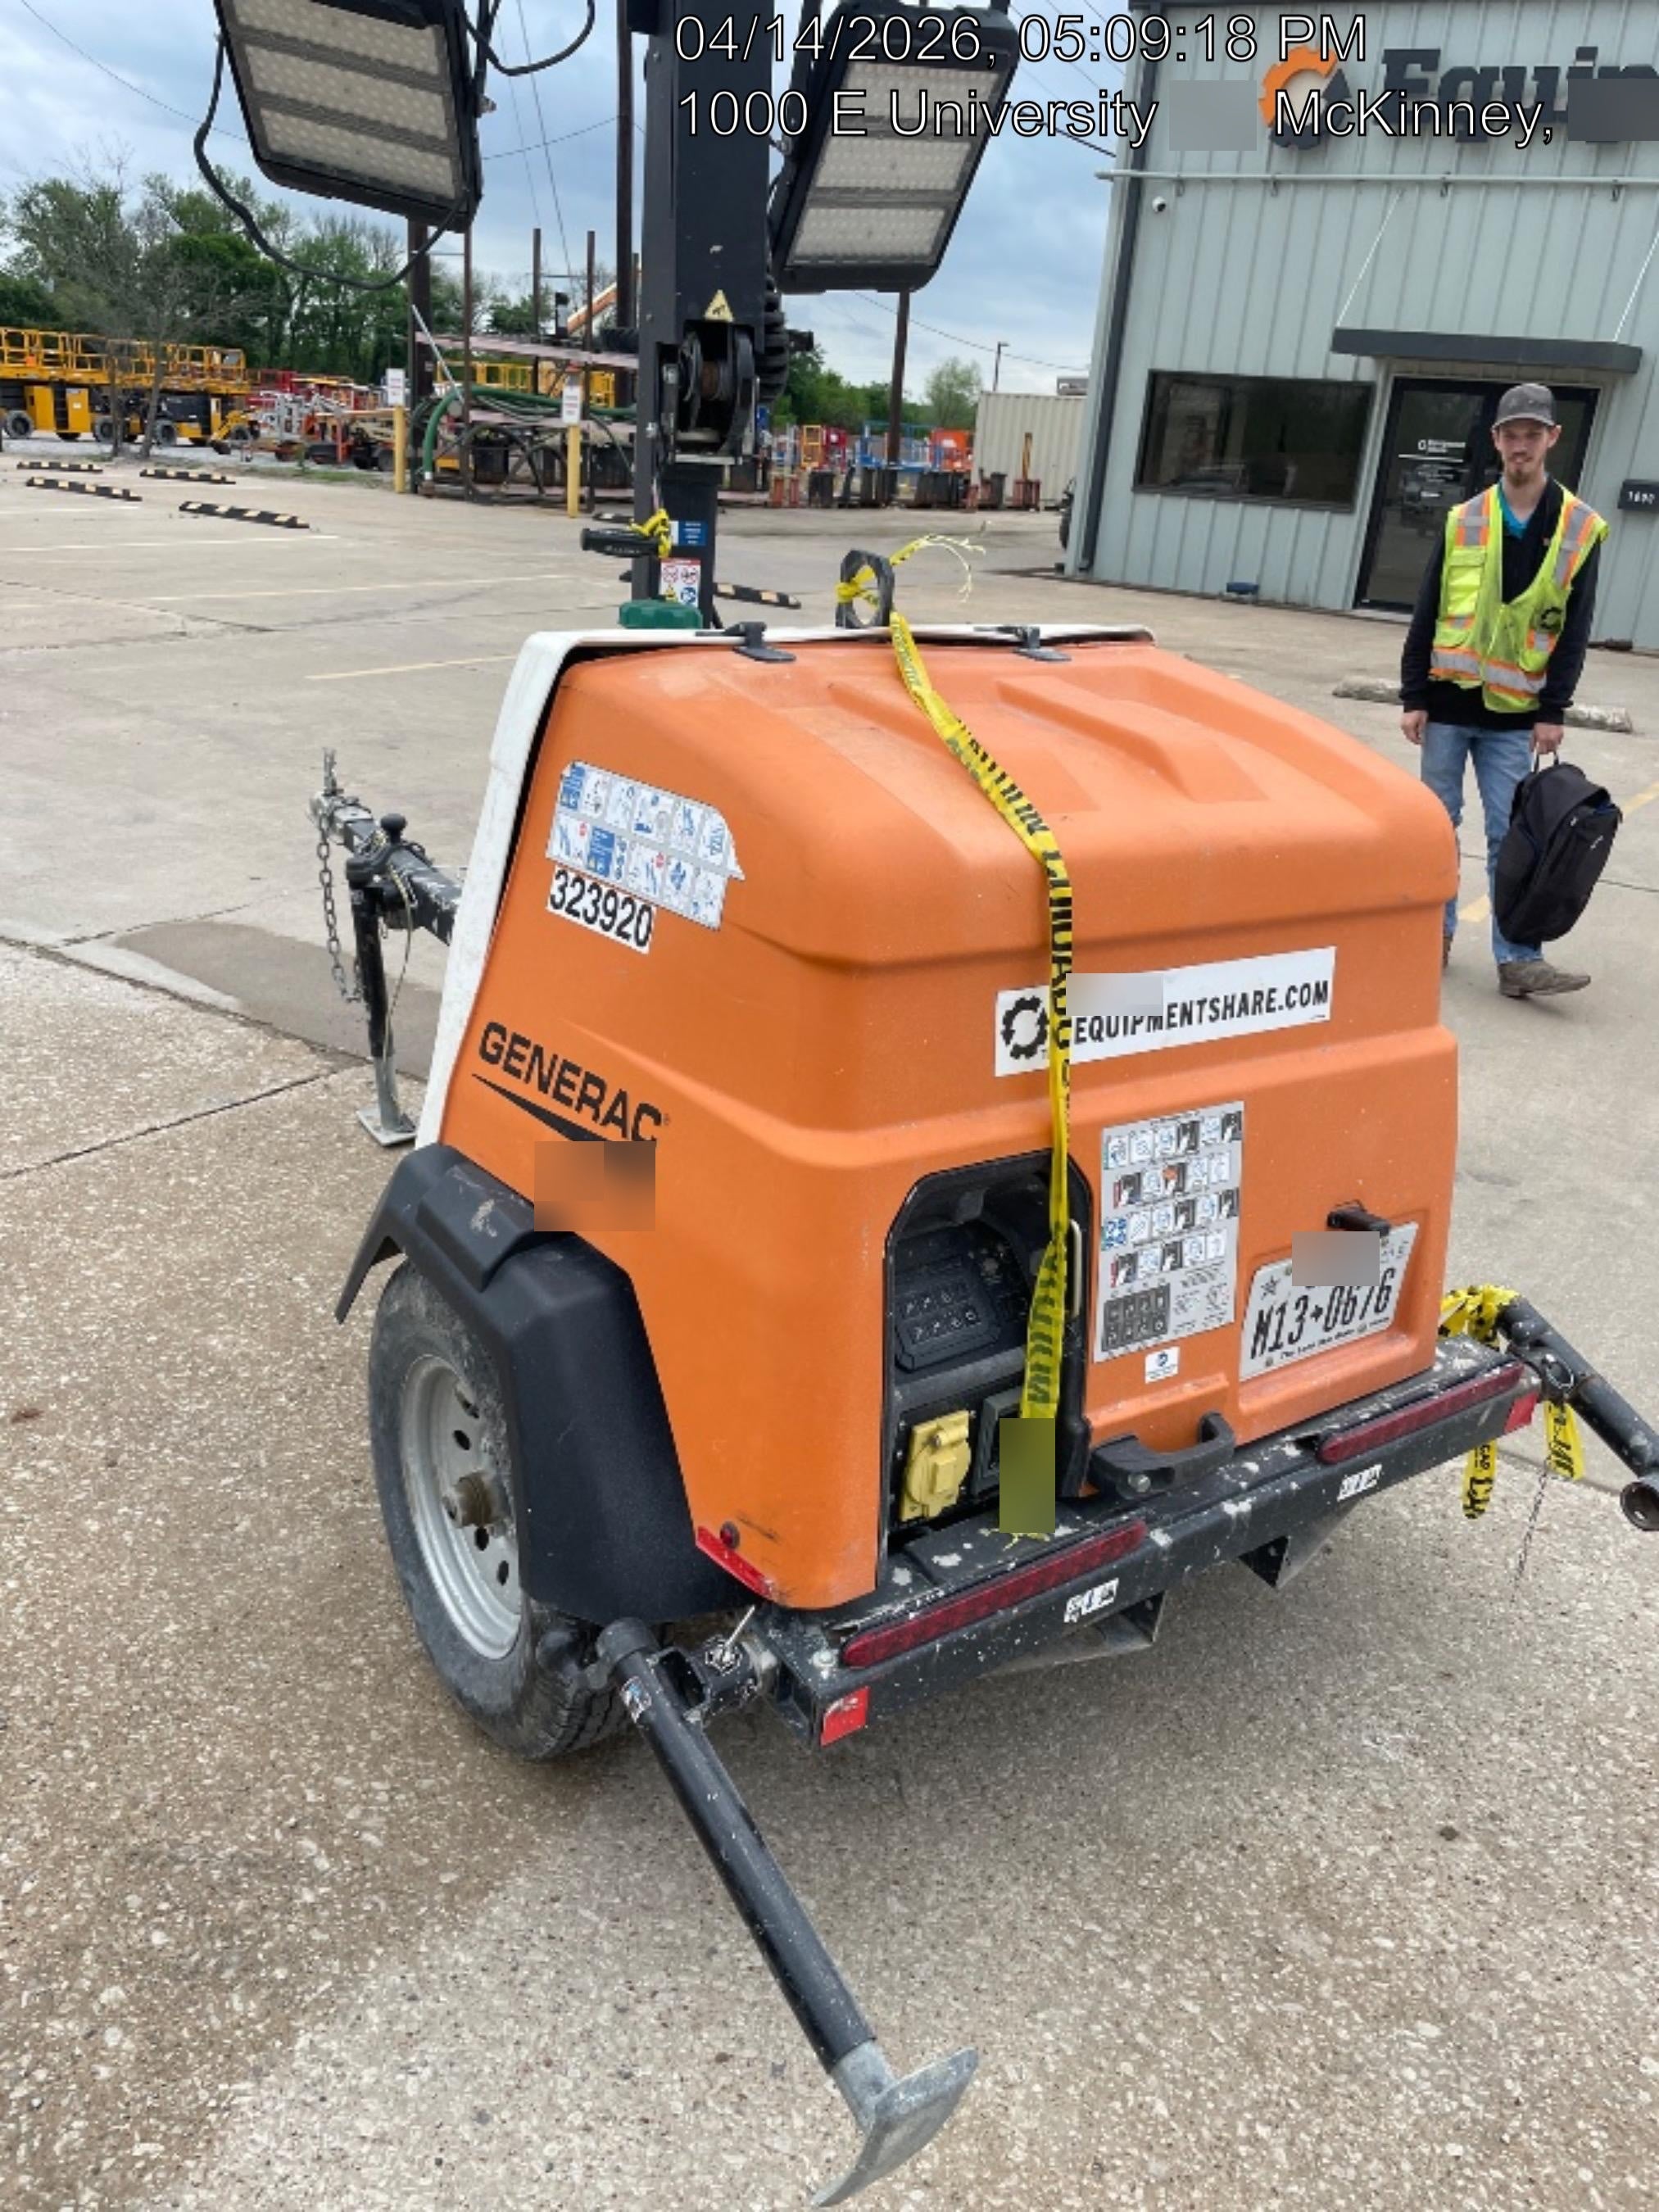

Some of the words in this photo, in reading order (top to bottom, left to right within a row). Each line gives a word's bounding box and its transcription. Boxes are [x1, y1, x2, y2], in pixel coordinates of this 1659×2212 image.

[550, 869, 653, 948] 323920
[1073, 981, 1328, 1045] EQUIPMENTSHARE.COM
[478, 1022, 662, 1147] GENERAC
